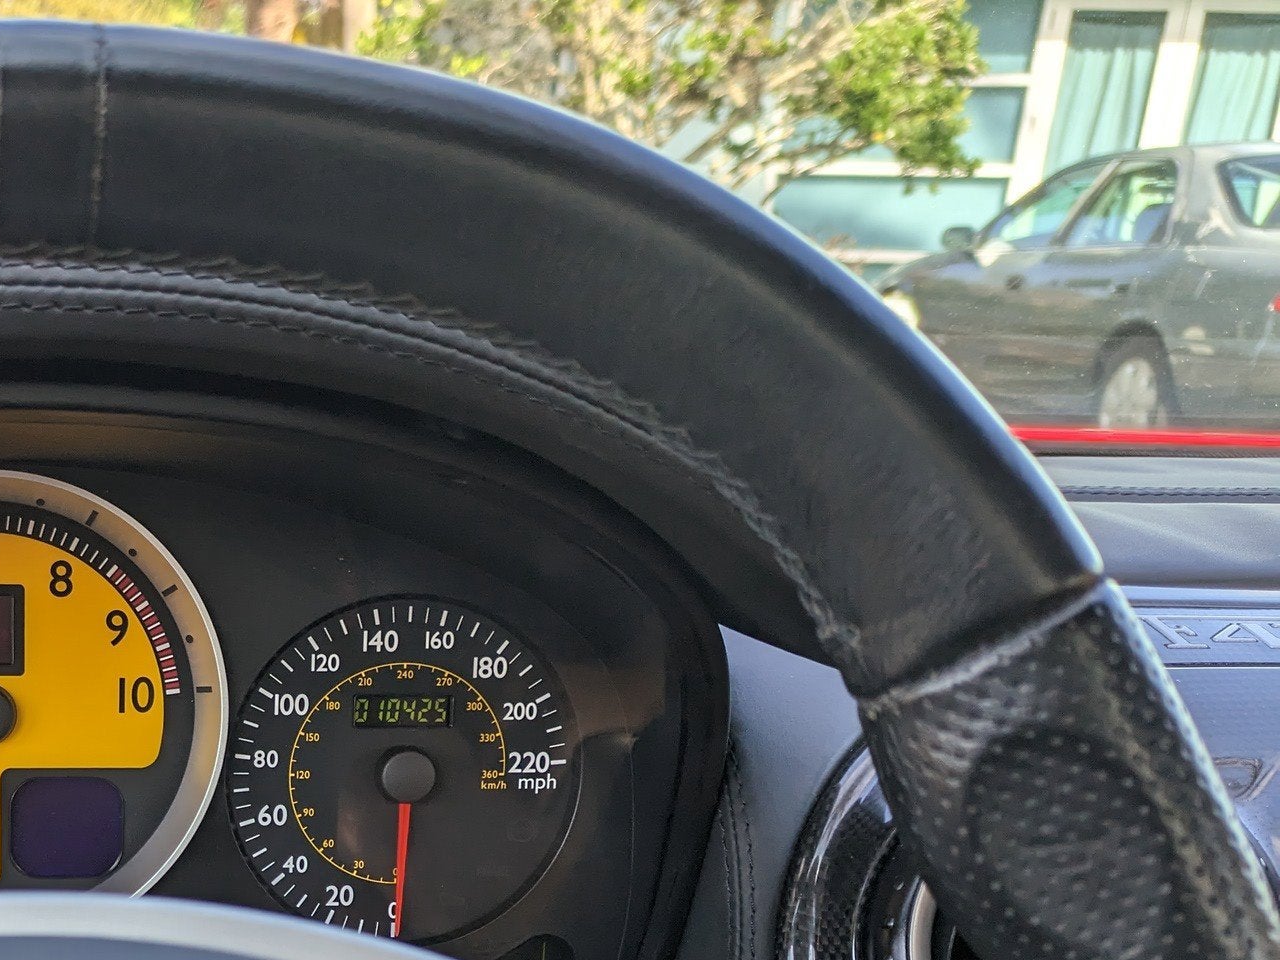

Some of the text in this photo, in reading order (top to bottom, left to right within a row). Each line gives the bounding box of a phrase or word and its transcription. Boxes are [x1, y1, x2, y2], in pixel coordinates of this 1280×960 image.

[47, 559, 74, 597] 8
[104, 608, 129, 647] 9
[362, 630, 400, 653] 140
[424, 630, 455, 651] 160
[310, 653, 340, 673] 120
[472, 656, 508, 679] 180
[357, 676, 373, 688] 210
[396, 669, 414, 679] 240
[436, 676, 453, 687] 270
[116, 676, 156, 714] 10
[273, 693, 310, 716] 100
[325, 700, 341, 711] 180
[466, 700, 484, 712] 300
[502, 701, 538, 721] 200
[305, 731, 320, 743] 150
[478, 731, 496, 743] 330
[253, 749, 279, 769] 80
[507, 750, 550, 774] 220
[295, 769, 311, 780] 120
[481, 769, 499, 780] 360
[517, 772, 558, 795] mph
[480, 780, 507, 791] km/h
[257, 803, 288, 827] 60
[302, 807, 315, 818] 90
[322, 838, 335, 849] 60
[282, 855, 309, 875] 40
[352, 860, 366, 871] 30
[325, 884, 355, 907] 20
